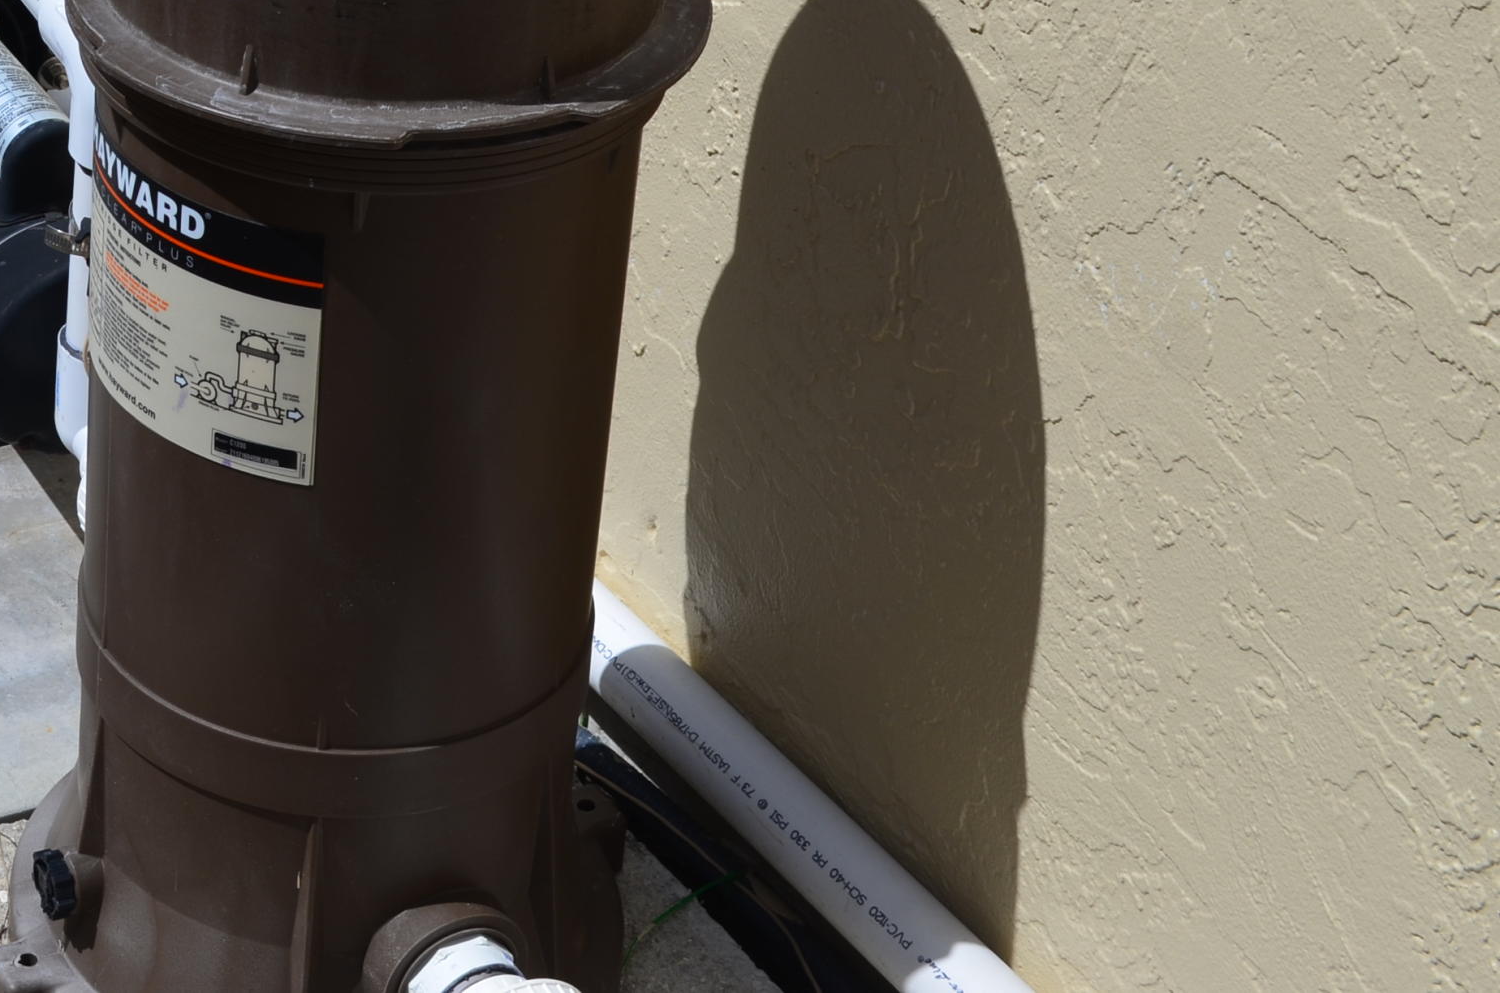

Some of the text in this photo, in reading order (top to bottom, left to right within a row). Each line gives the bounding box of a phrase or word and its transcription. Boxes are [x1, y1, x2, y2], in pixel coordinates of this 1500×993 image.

[127, 237, 168, 272] FILTER
[146, 232, 194, 268] PLUS
[766, 808, 792, 832] PSI
[787, 827, 813, 853] 330
[809, 849, 830, 869] PR
[827, 866, 870, 907] SCH-40
[866, 904, 915, 951] PVC-1120
